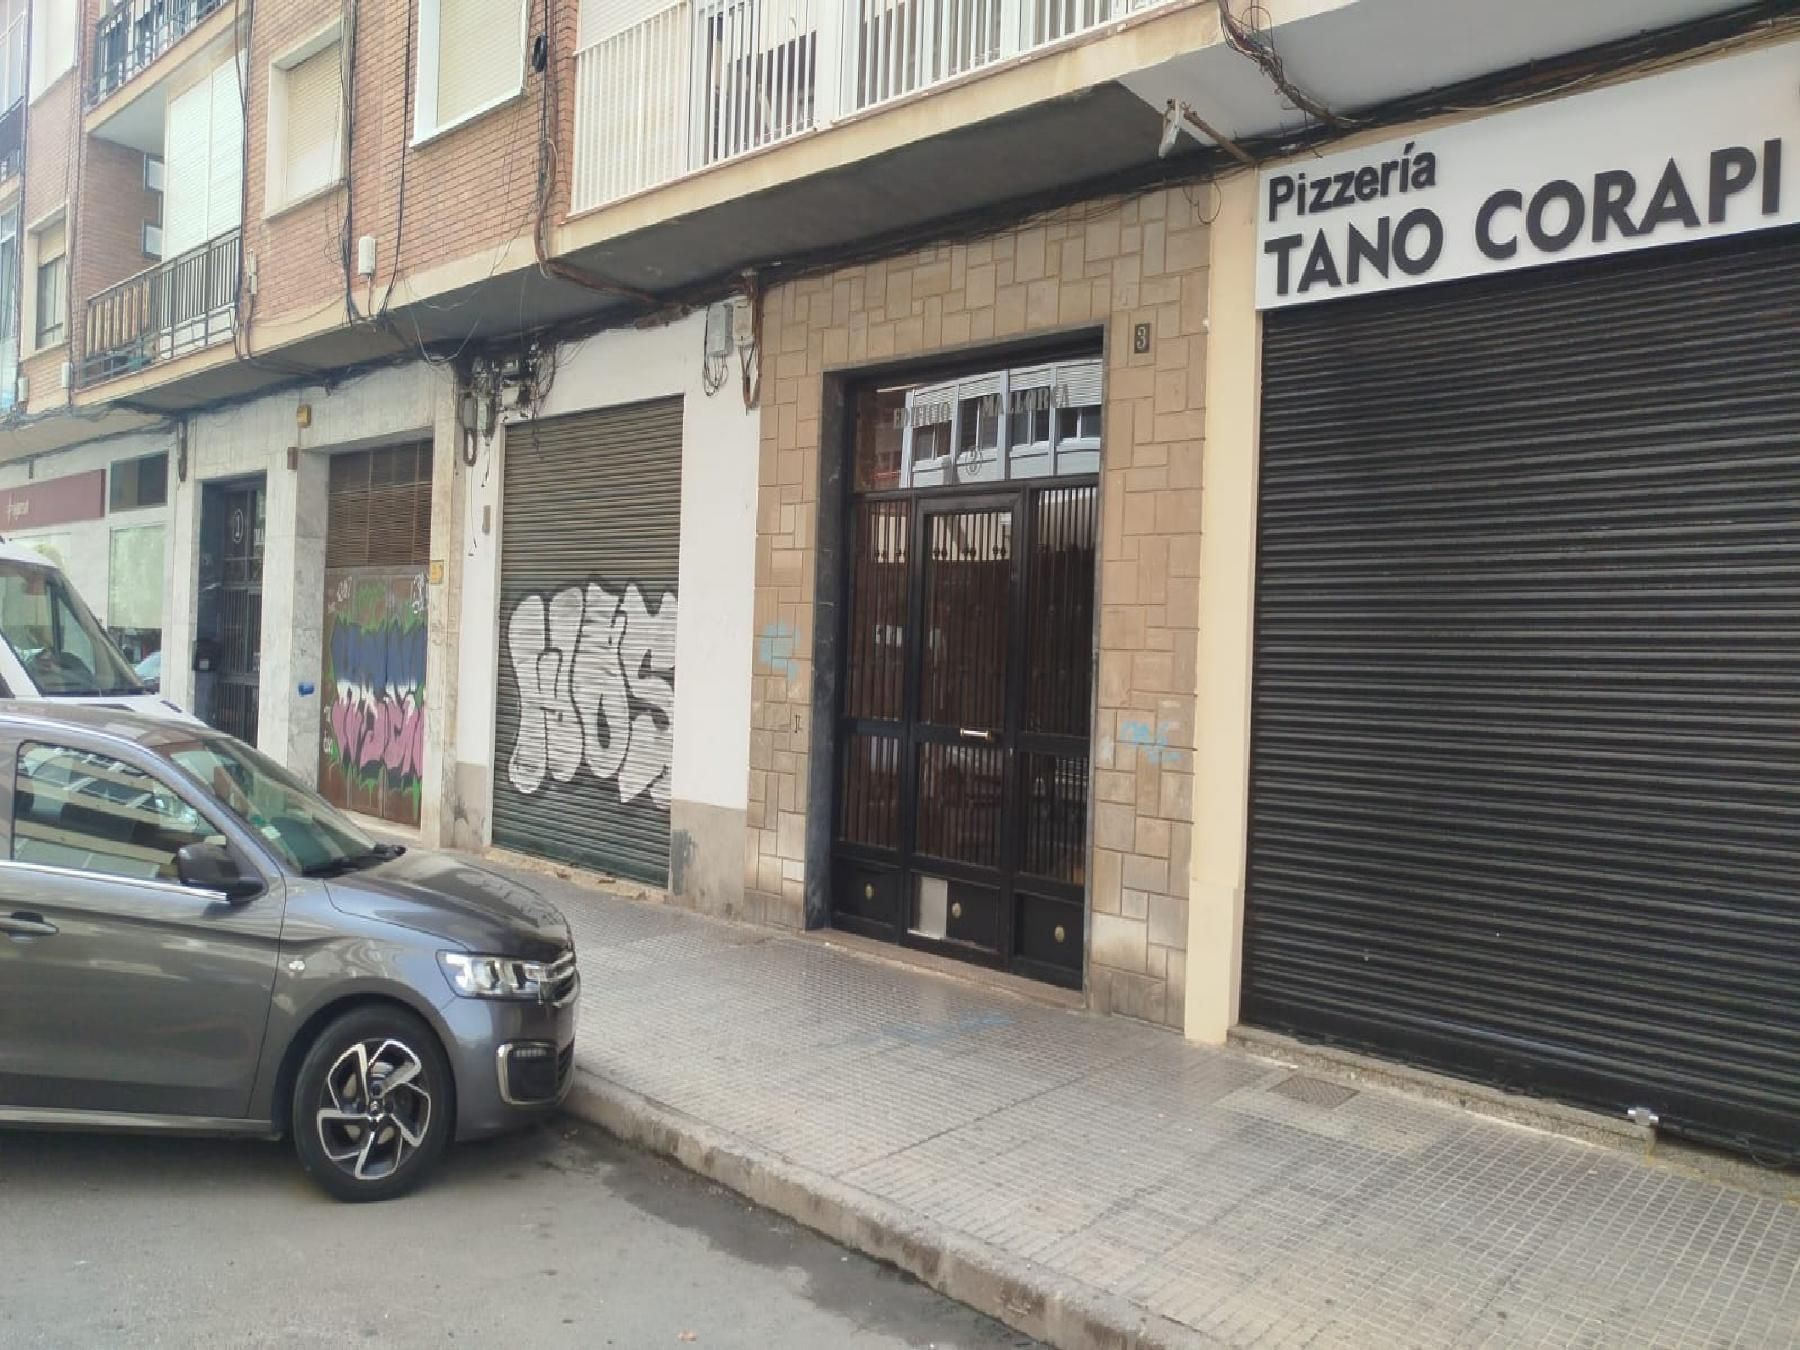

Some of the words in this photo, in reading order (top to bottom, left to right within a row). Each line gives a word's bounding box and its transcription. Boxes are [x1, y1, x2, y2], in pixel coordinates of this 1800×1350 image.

[1268, 141, 1436, 222] Pizzería
[1264, 208, 1444, 295] TANO
[1475, 138, 1782, 260] CORAPI
[1136, 325, 1146, 349] 3
[980, 384, 1070, 416] MALLORCA
